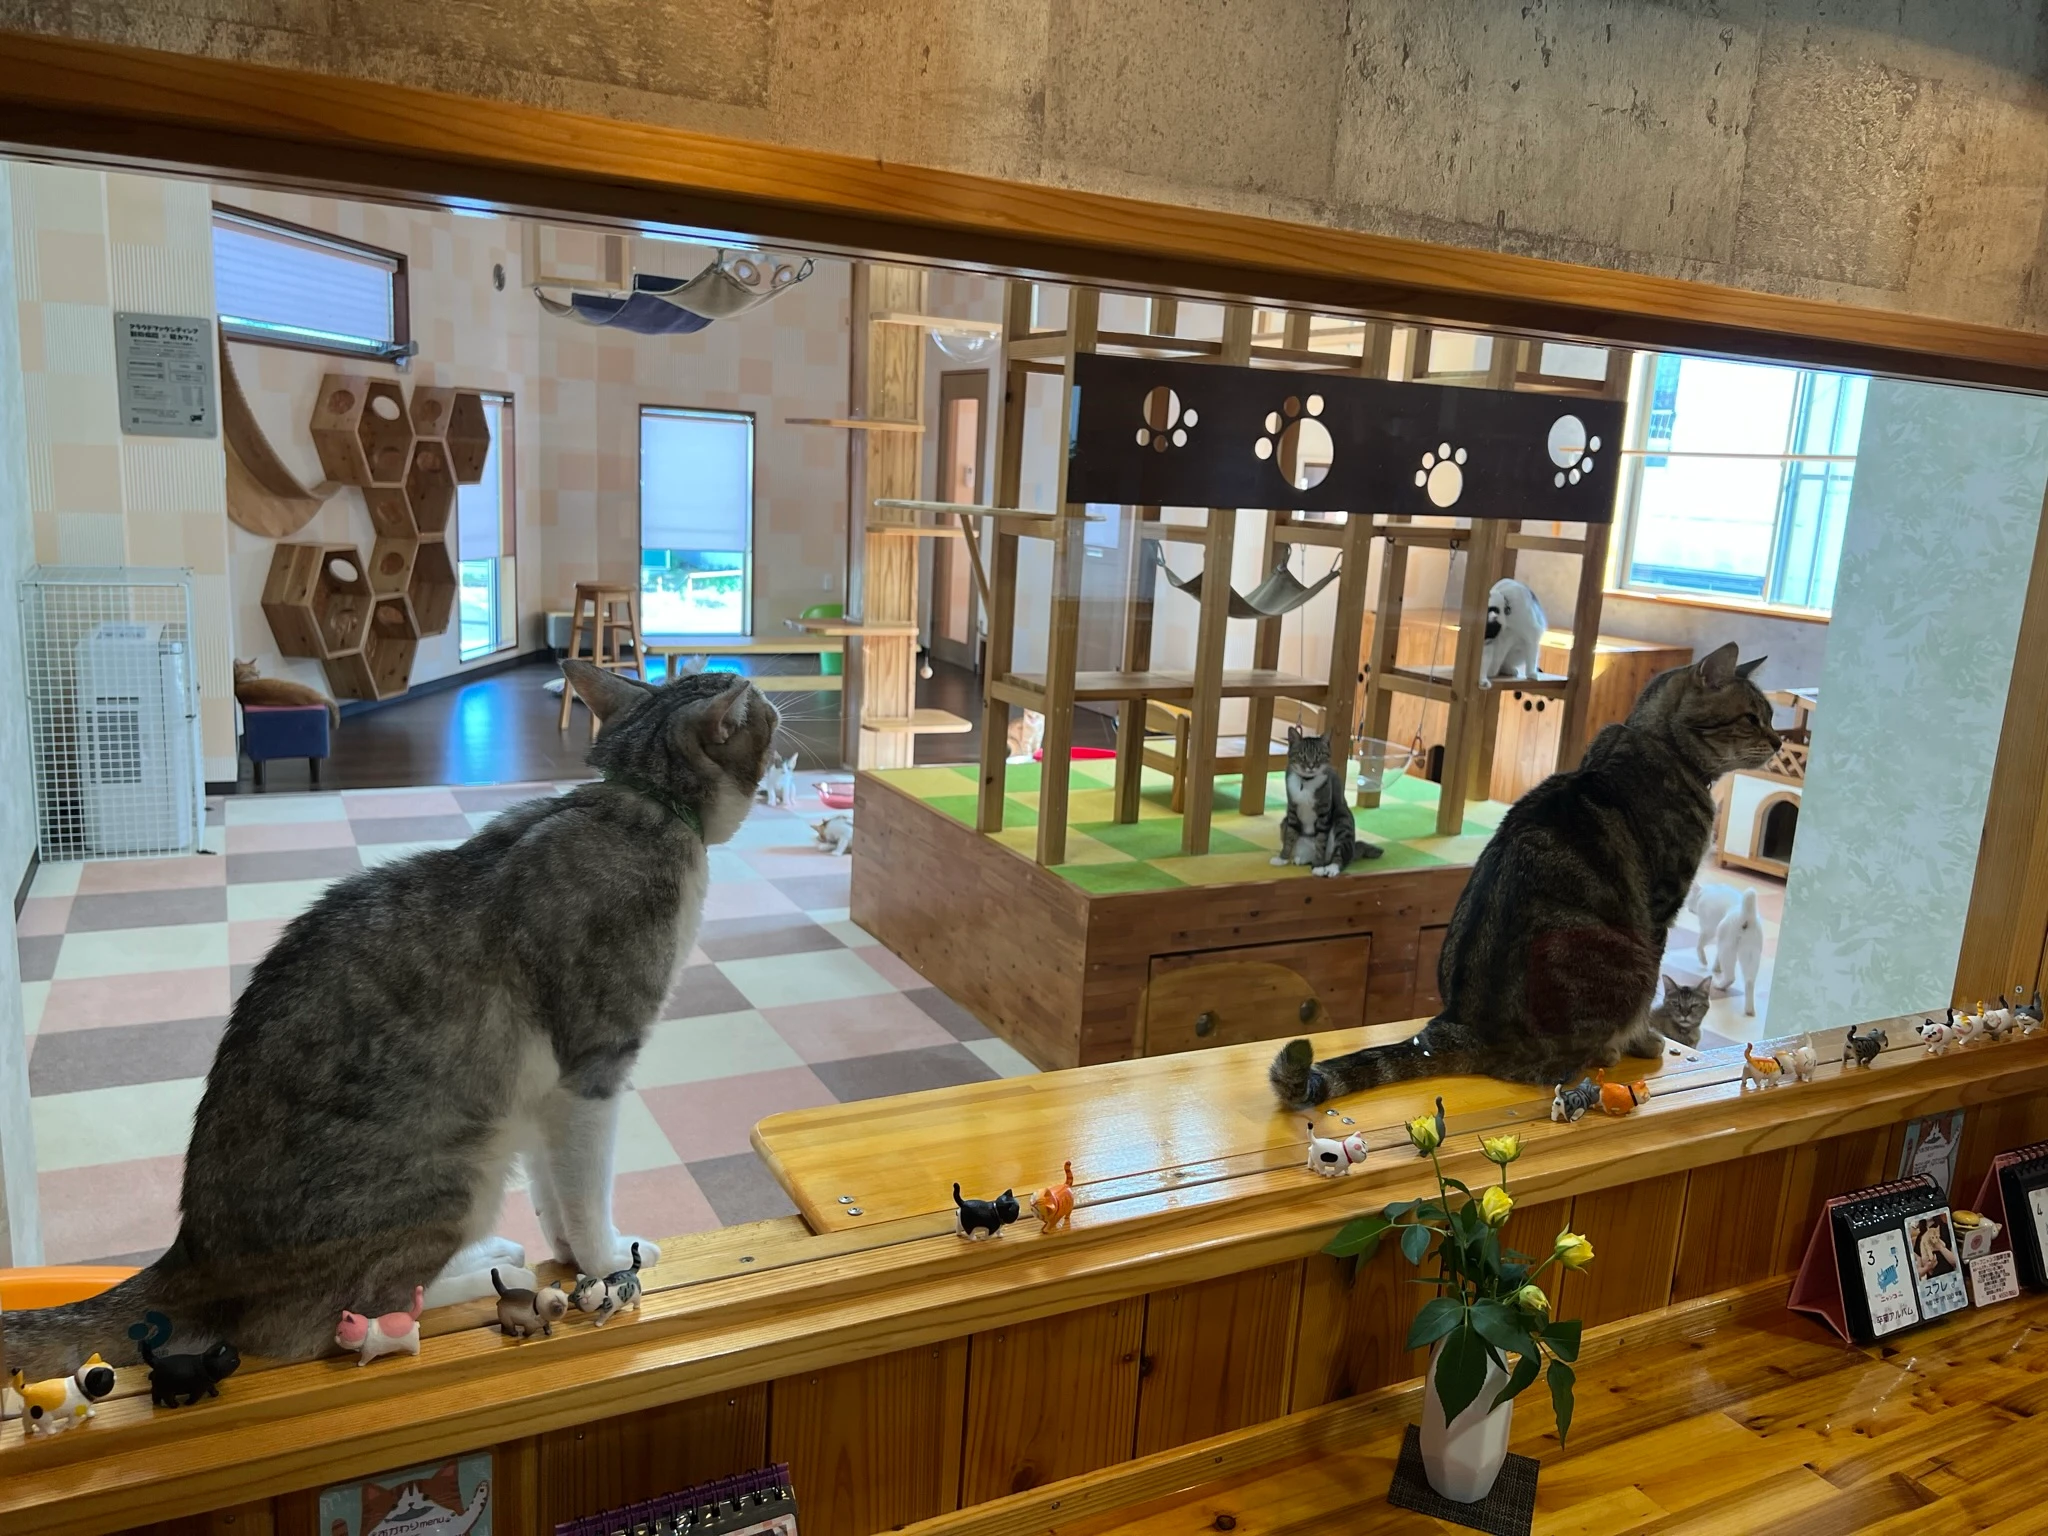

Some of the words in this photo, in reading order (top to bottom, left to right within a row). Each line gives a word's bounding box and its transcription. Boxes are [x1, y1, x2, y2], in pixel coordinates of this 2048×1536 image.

[2036, 1202, 2044, 1216] 4
[1866, 1249, 1876, 1266] 3
[1925, 1281, 1948, 1297] スフレ
